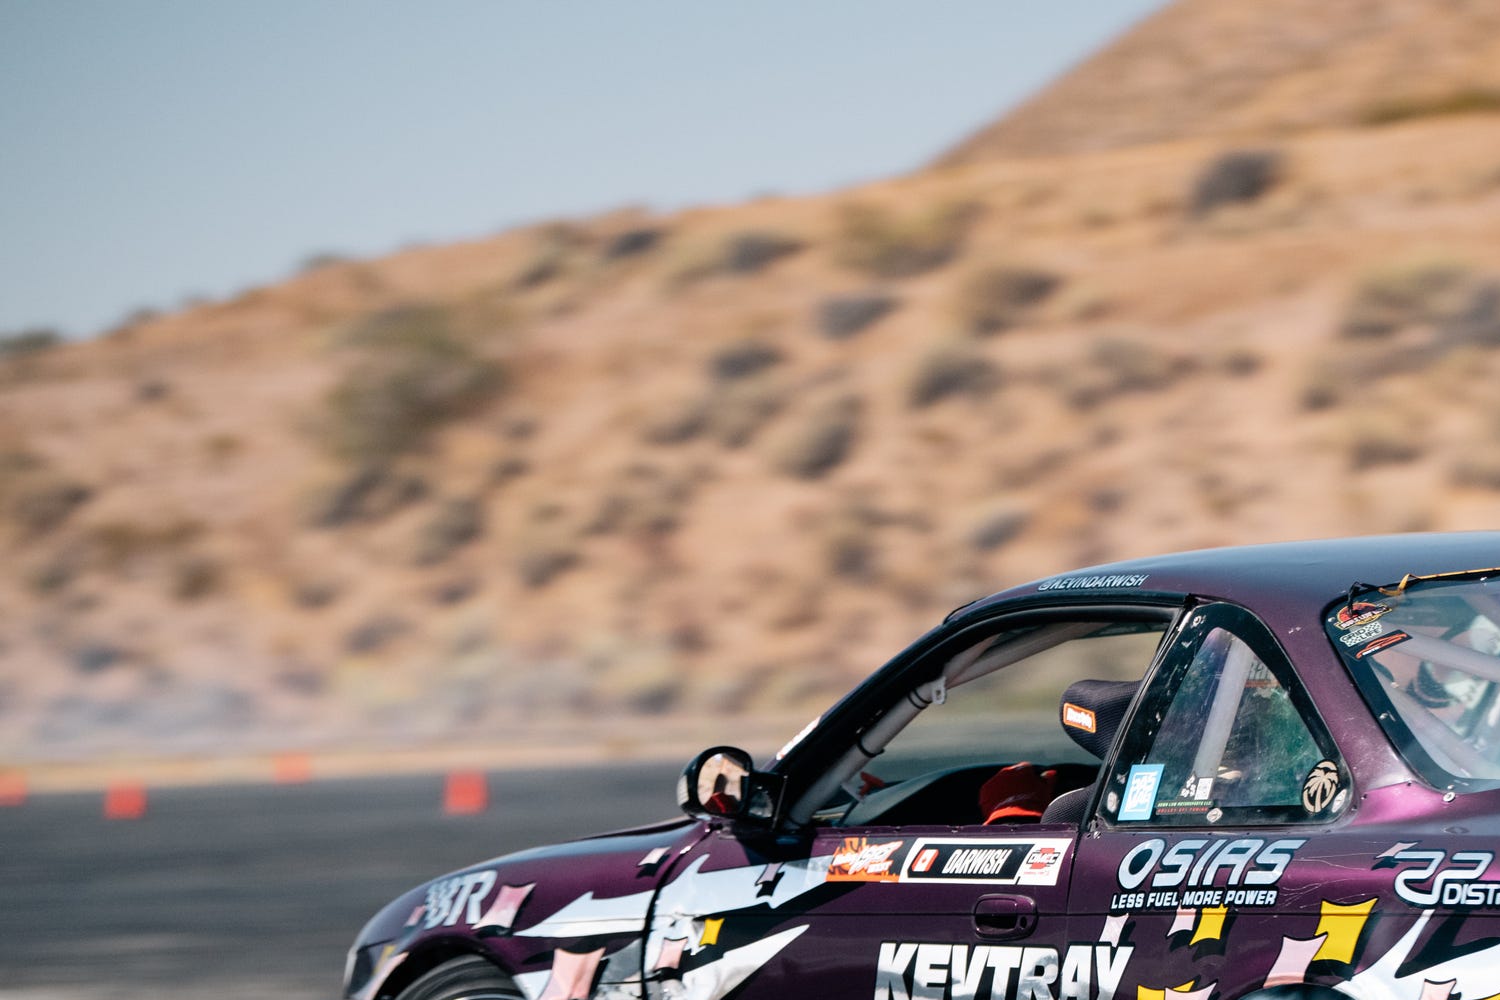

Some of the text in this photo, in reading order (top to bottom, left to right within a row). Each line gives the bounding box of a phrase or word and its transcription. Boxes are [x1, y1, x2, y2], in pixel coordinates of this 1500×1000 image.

[941, 848, 1013, 875] DARWISH
[1118, 838, 1307, 890] OSIAS
[1111, 890, 1278, 910] LESS FUEL MORE POWER
